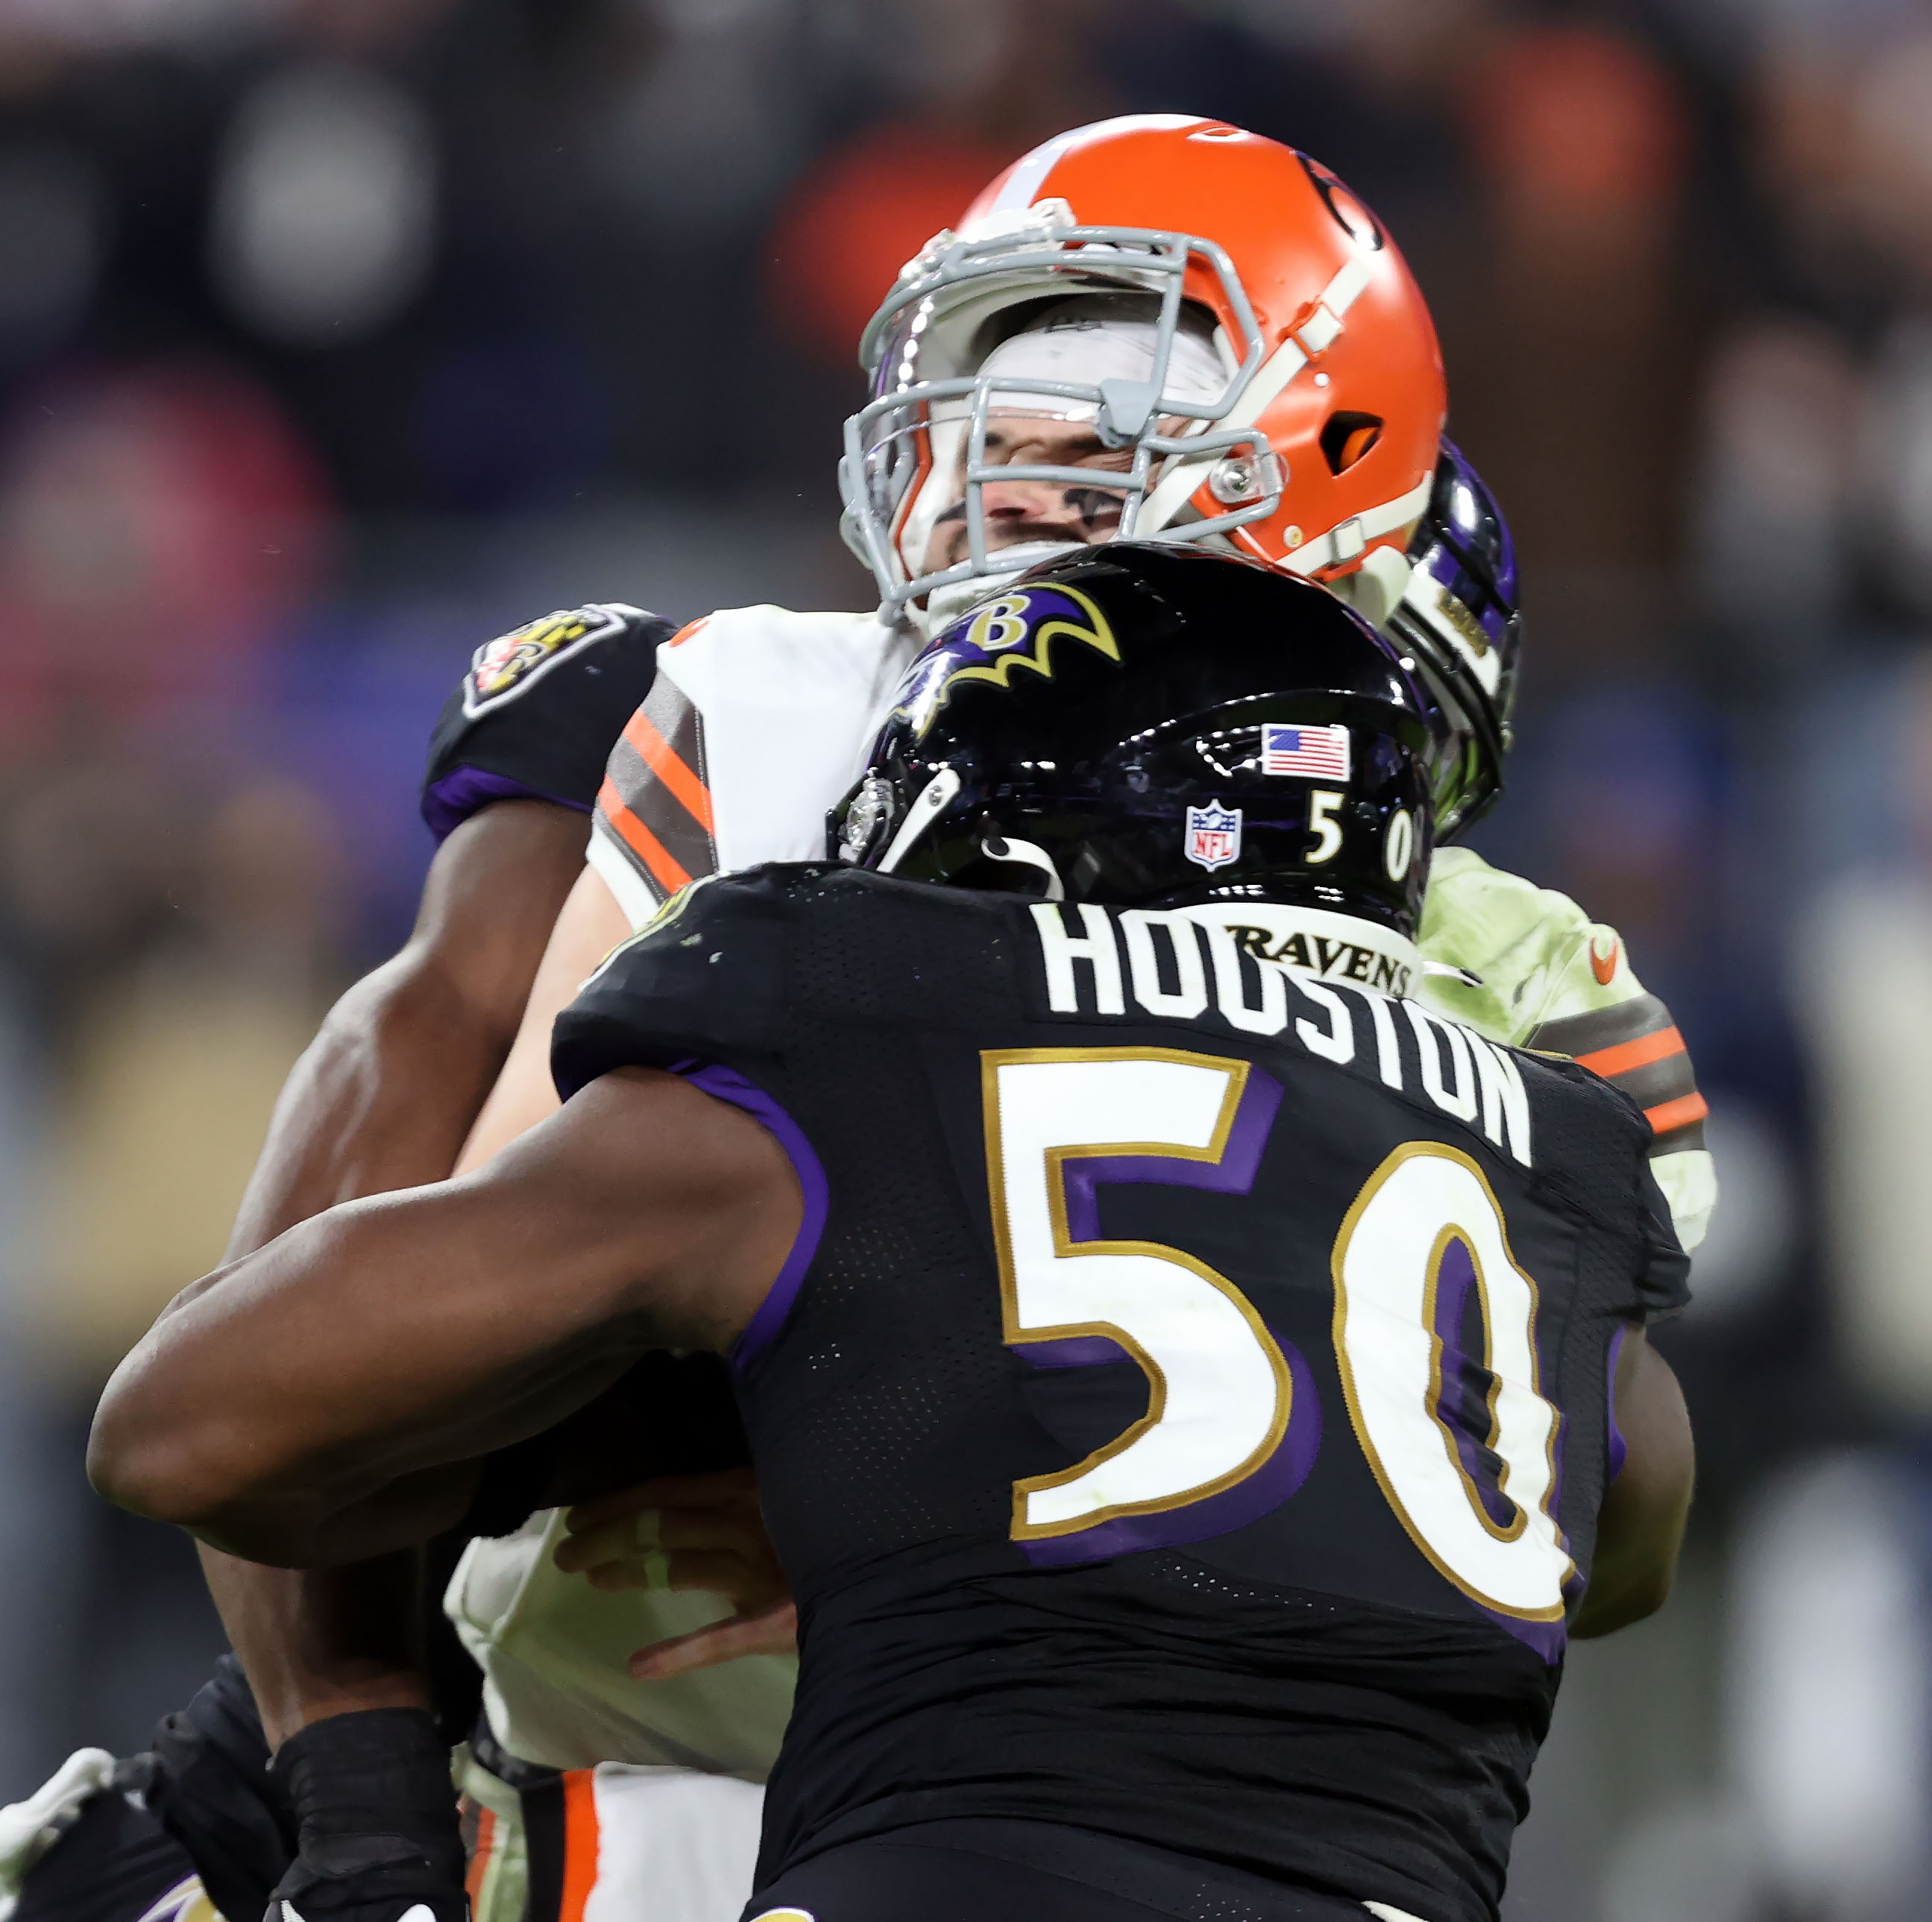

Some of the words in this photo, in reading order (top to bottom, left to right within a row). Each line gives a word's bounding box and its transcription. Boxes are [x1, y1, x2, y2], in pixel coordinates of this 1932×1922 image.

[966, 594, 1032, 651] B
[1194, 832, 1232, 860] NFL
[1223, 924, 1412, 997] RAVENS
[1029, 902, 1532, 1169] HOUSTON
[980, 1046, 1579, 1633] 50
